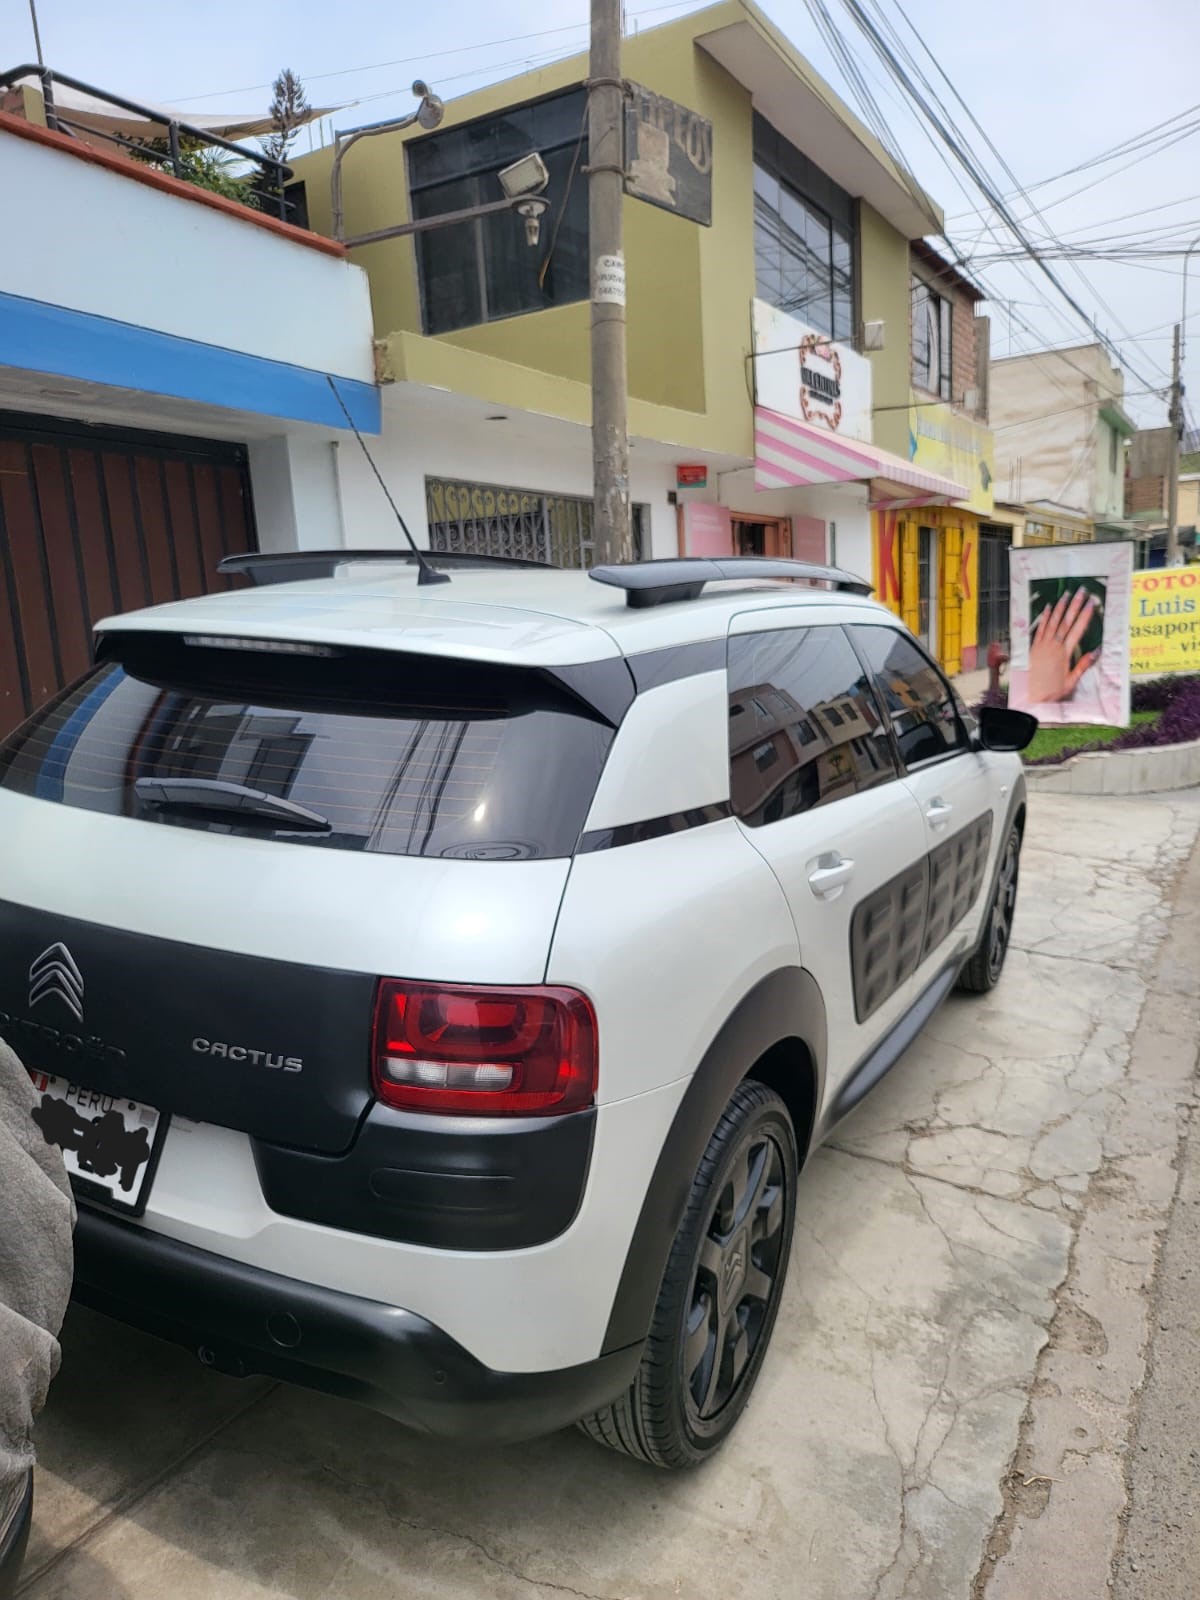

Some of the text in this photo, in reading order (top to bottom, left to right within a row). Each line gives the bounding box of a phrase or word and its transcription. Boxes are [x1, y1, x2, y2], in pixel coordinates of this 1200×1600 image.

[1139, 595, 1196, 617] Luis
[192, 1038, 303, 1073] CACTUS
[65, 1082, 114, 1113] PERU
